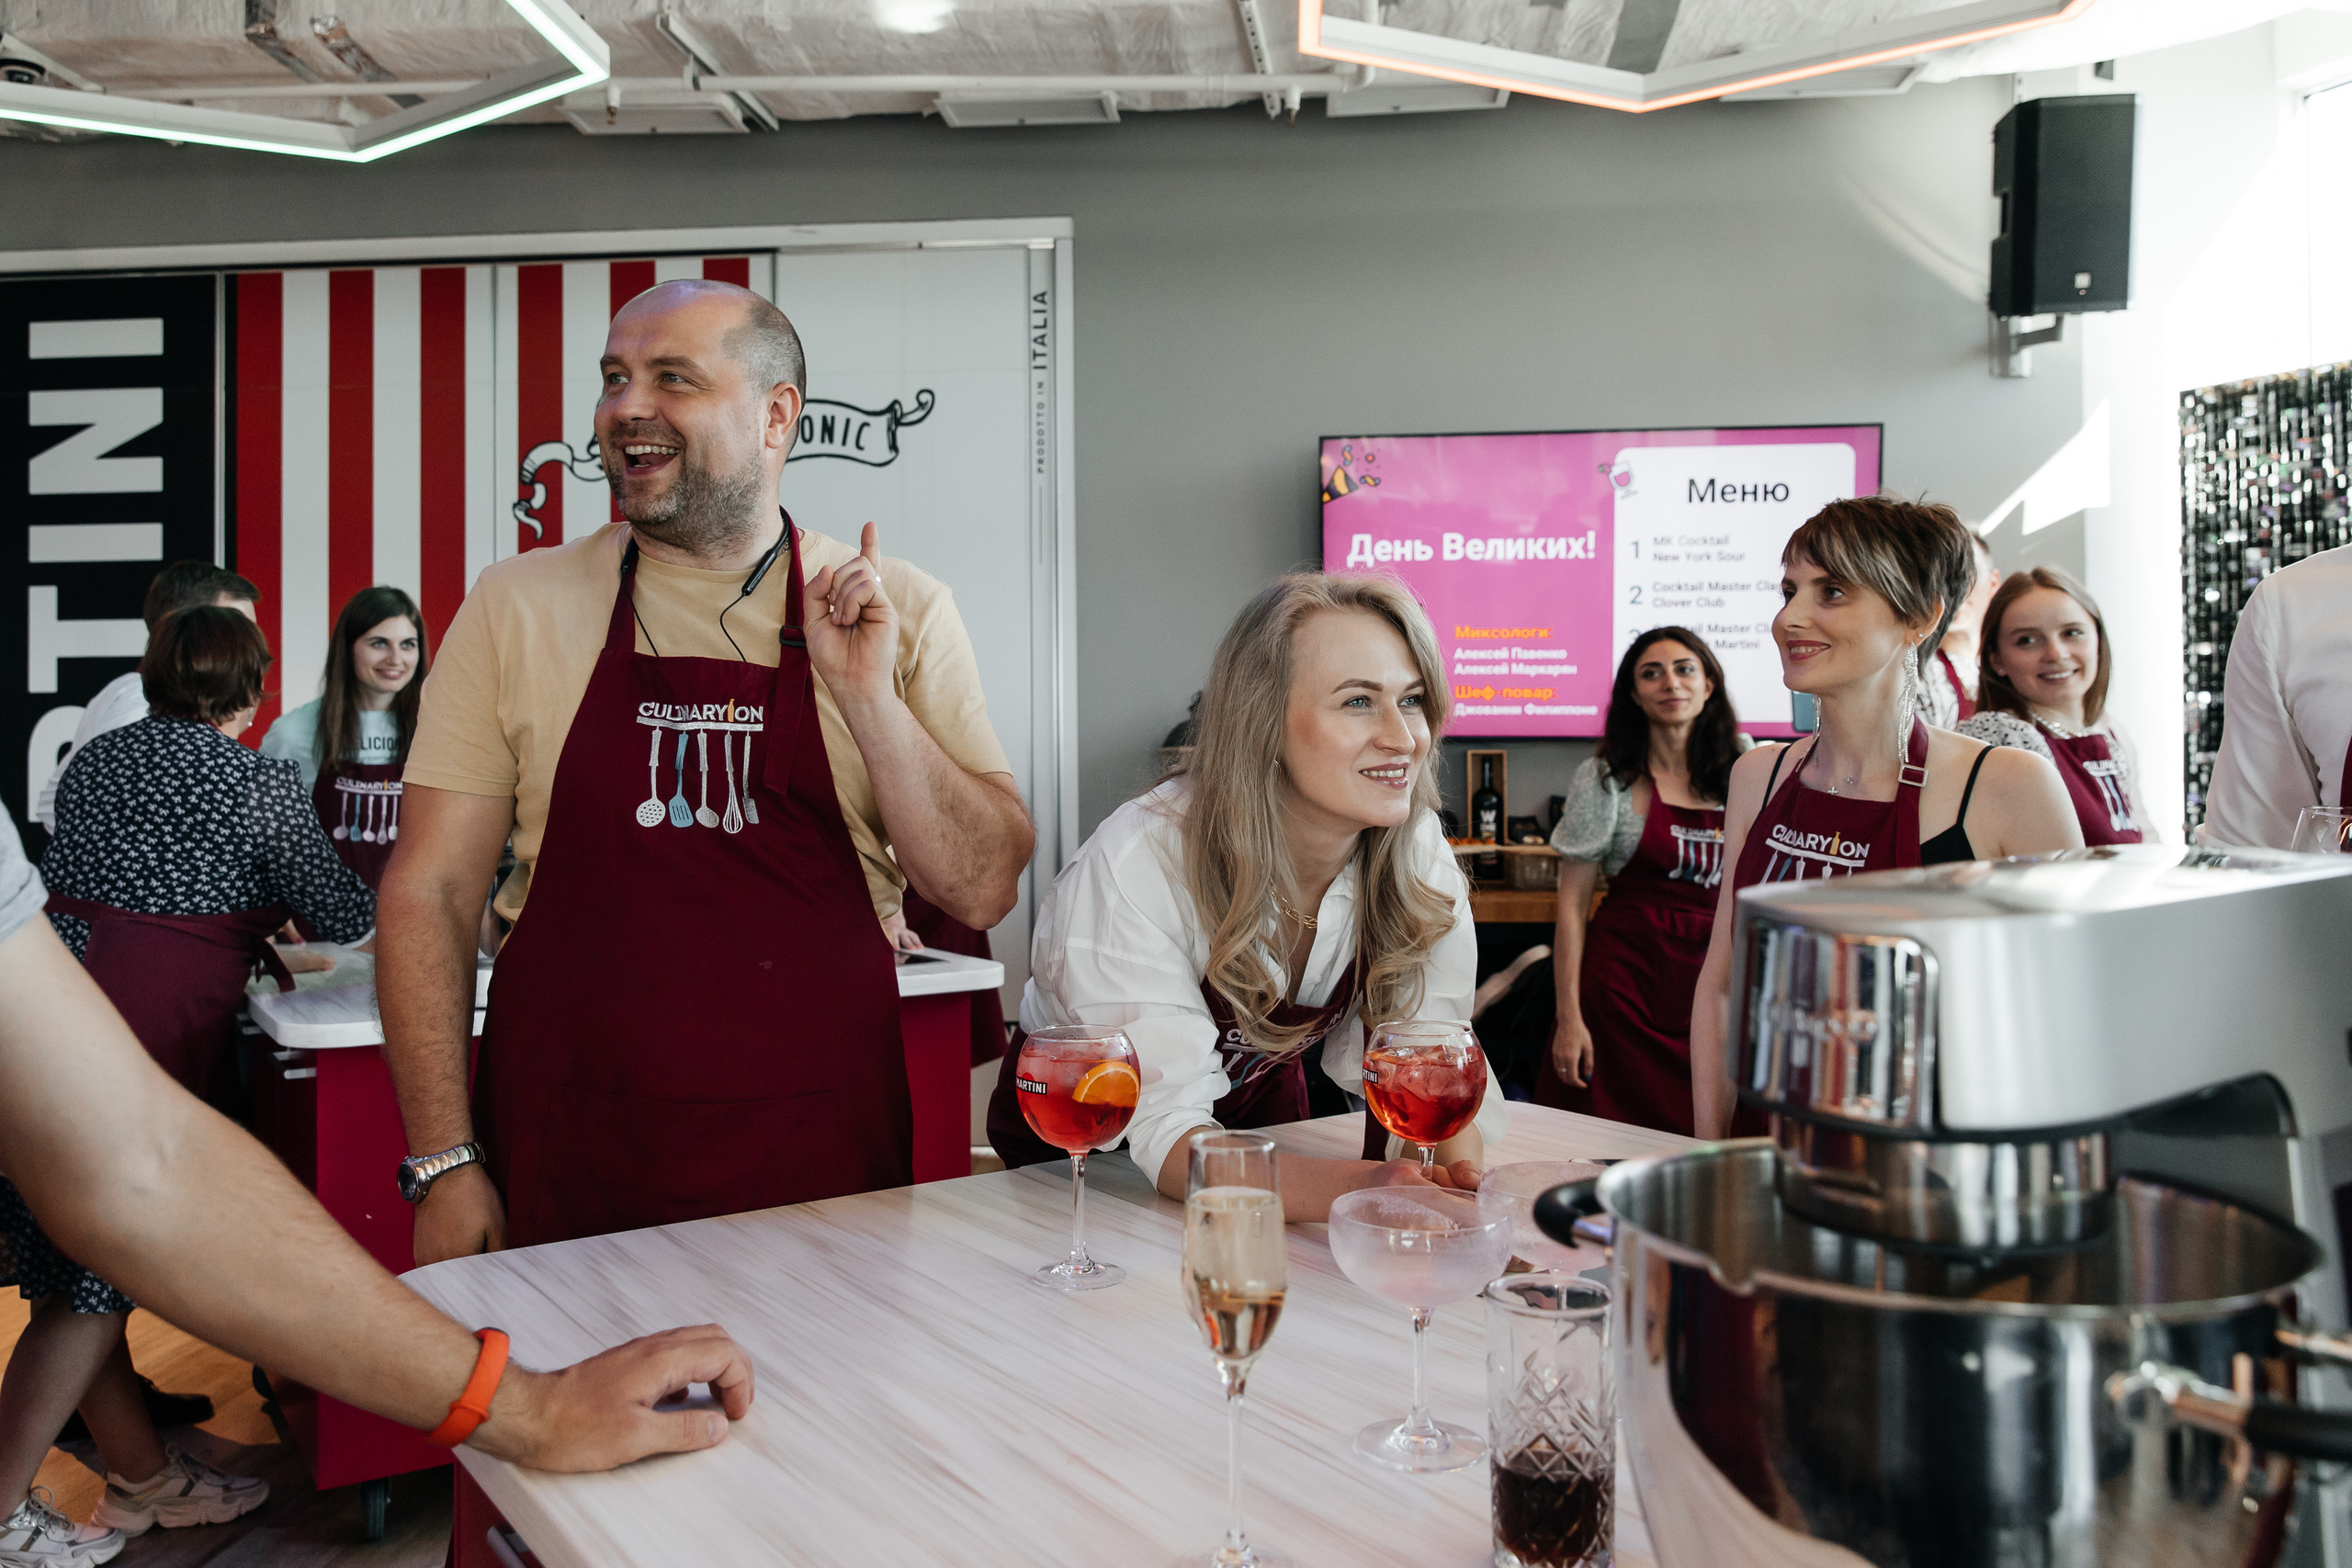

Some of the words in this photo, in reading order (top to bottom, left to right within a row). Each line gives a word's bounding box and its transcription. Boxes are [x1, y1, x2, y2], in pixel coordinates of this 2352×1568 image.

[1033, 290, 1048, 370] ITALIA
[1037, 380, 1045, 395] IN
[1036, 402, 1046, 474] PRODOTTO
[1688, 478, 1790, 503] Меню
[1346, 533, 1434, 568] День
[1442, 530, 1597, 561] Великих!
[1630, 540, 1640, 558] 1
[1678, 535, 1730, 547] Cocktail
[1653, 552, 1679, 563] New
[1684, 551, 1713, 562] York
[1716, 551, 1746, 561] Sour
[1629, 585, 1643, 604] 2
[1653, 580, 1704, 592] Cocktail
[1708, 581, 1752, 592] Master
[1653, 597, 1691, 608] Clover
[1696, 596, 1724, 608] Club
[1453, 625, 1555, 639] Миксологи:
[1713, 638, 1760, 649] Martini
[1453, 647, 1510, 660] Алексей
[1453, 662, 1510, 675] Алексей
[1453, 683, 1558, 703] Шеф-повар:
